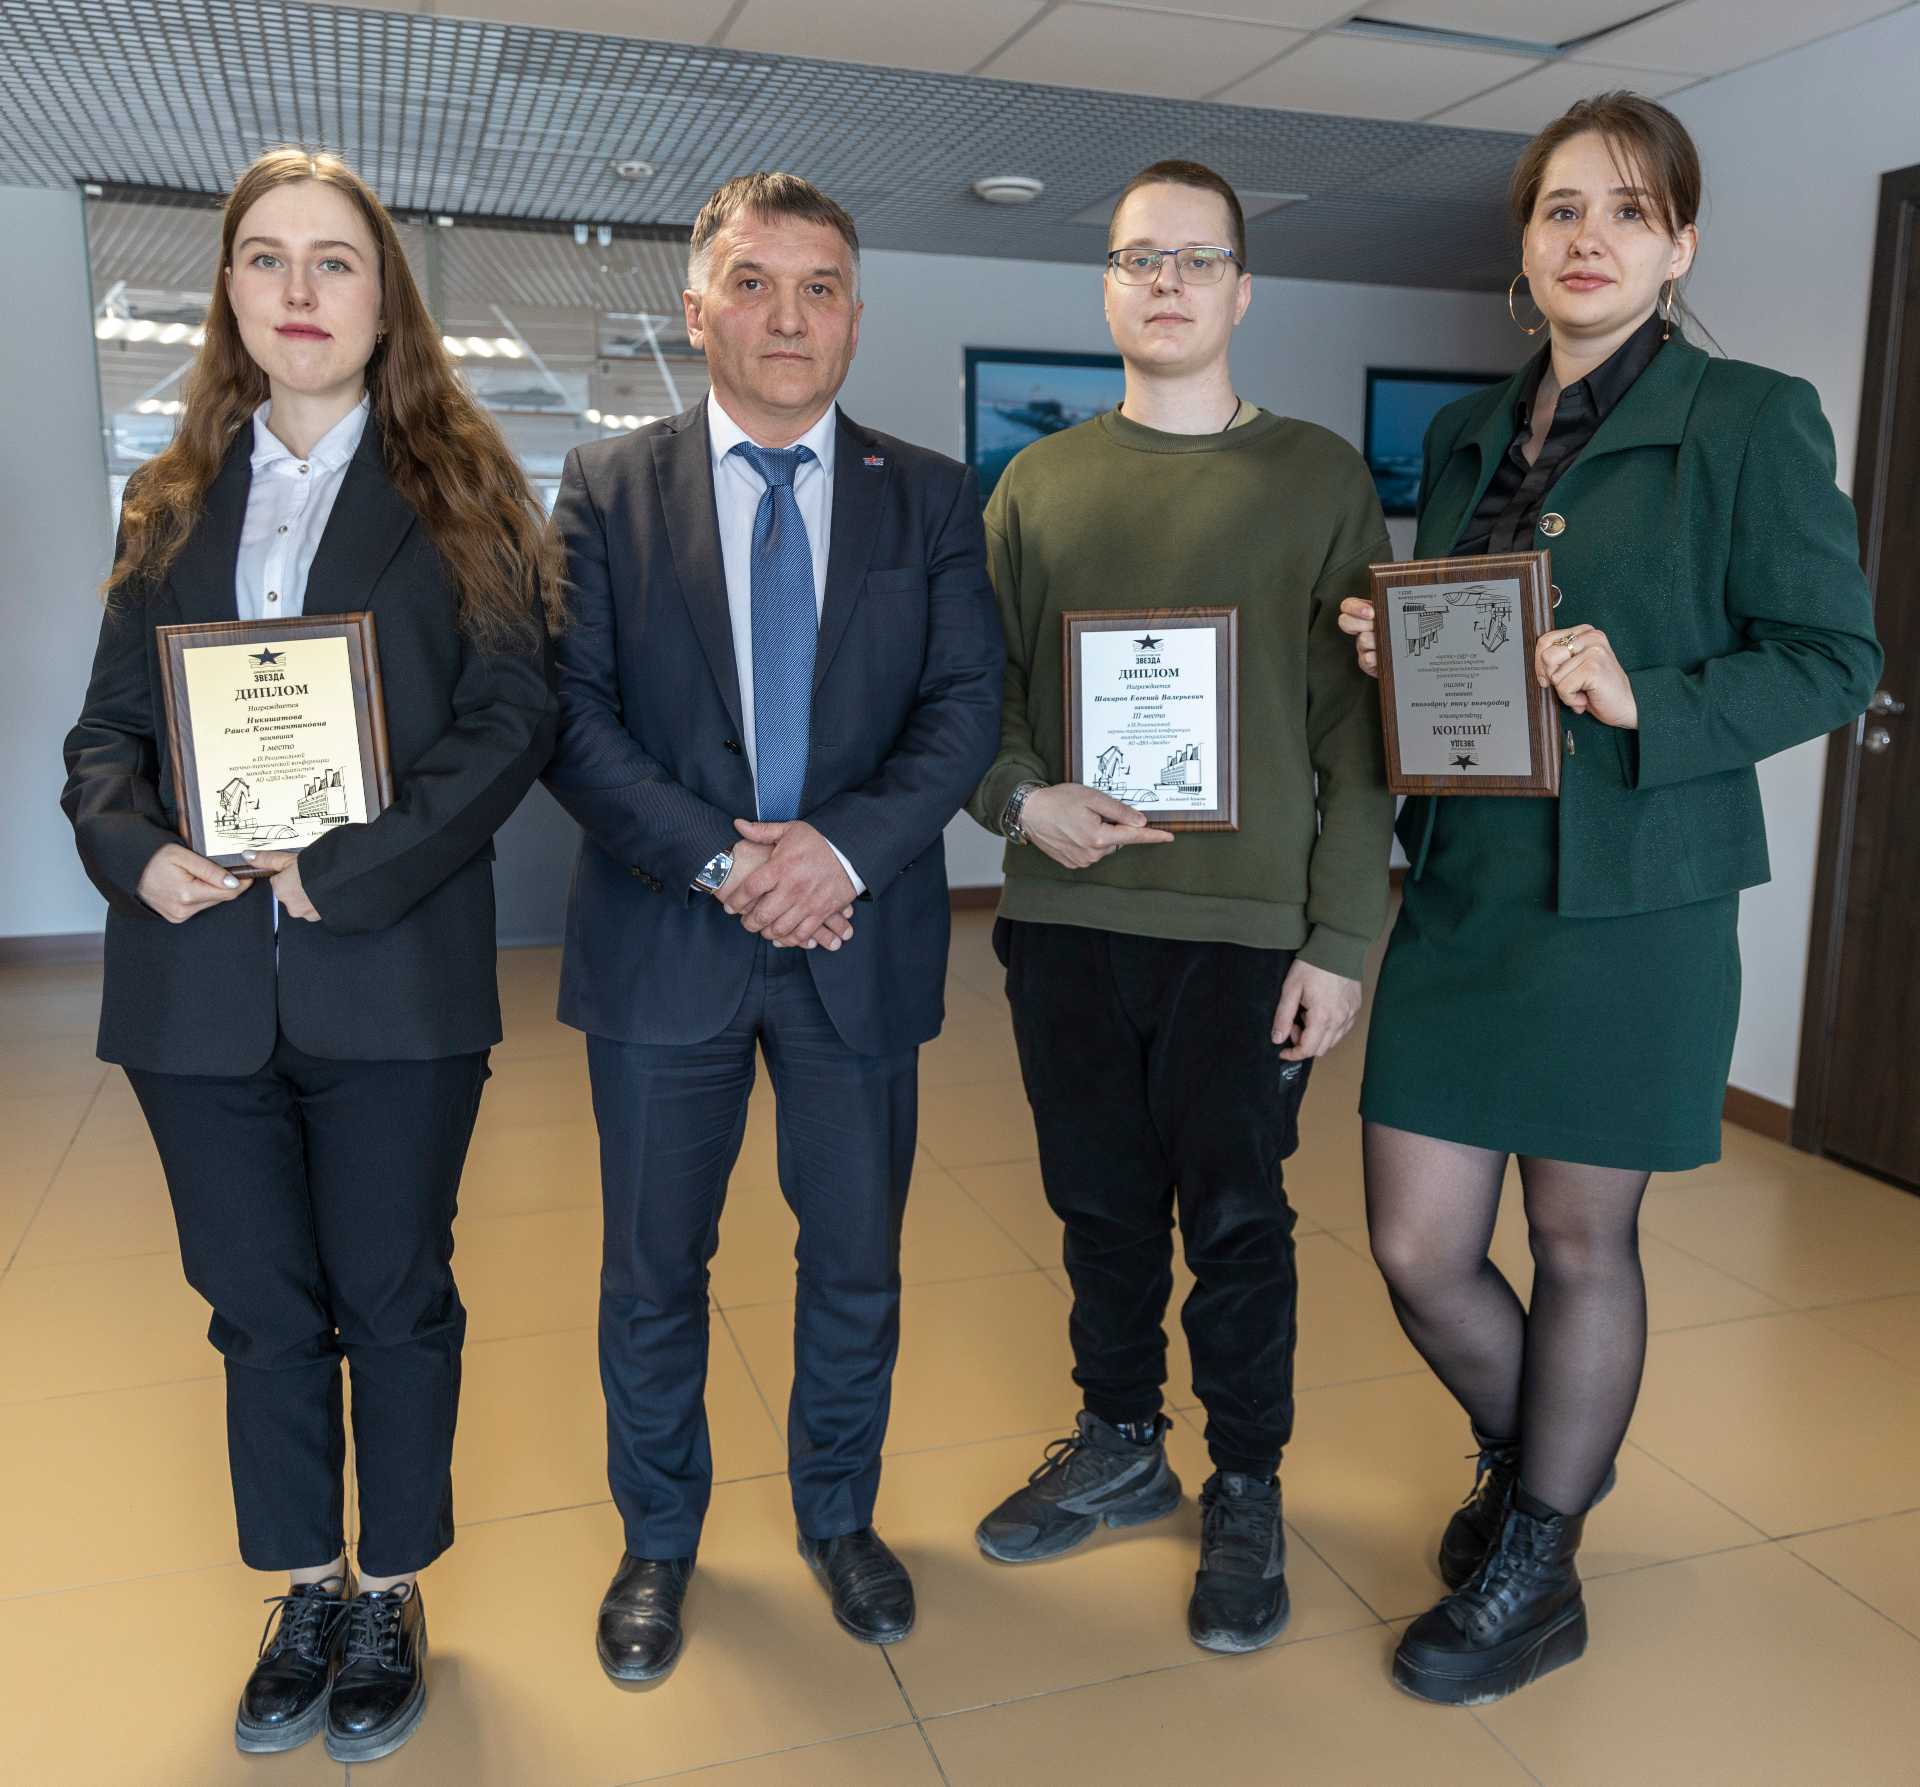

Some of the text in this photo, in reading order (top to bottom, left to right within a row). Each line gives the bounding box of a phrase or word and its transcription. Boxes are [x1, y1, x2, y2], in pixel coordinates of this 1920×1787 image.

[254, 673, 285, 682] ЗВЕЗДА
[1118, 668, 1180, 680] ДИПЛОМ
[235, 684, 309, 701] ДИПЛОМ
[1161, 693, 1204, 701] Валерьевич
[248, 703, 299, 712] Награждается
[1450, 700, 1467, 708] Анна
[253, 721, 327, 733] Константиновна
[1432, 723, 1491, 735] ДИПЛОМ
[1451, 739, 1475, 747] ЗВЕЗДА
[267, 744, 295, 752] место
